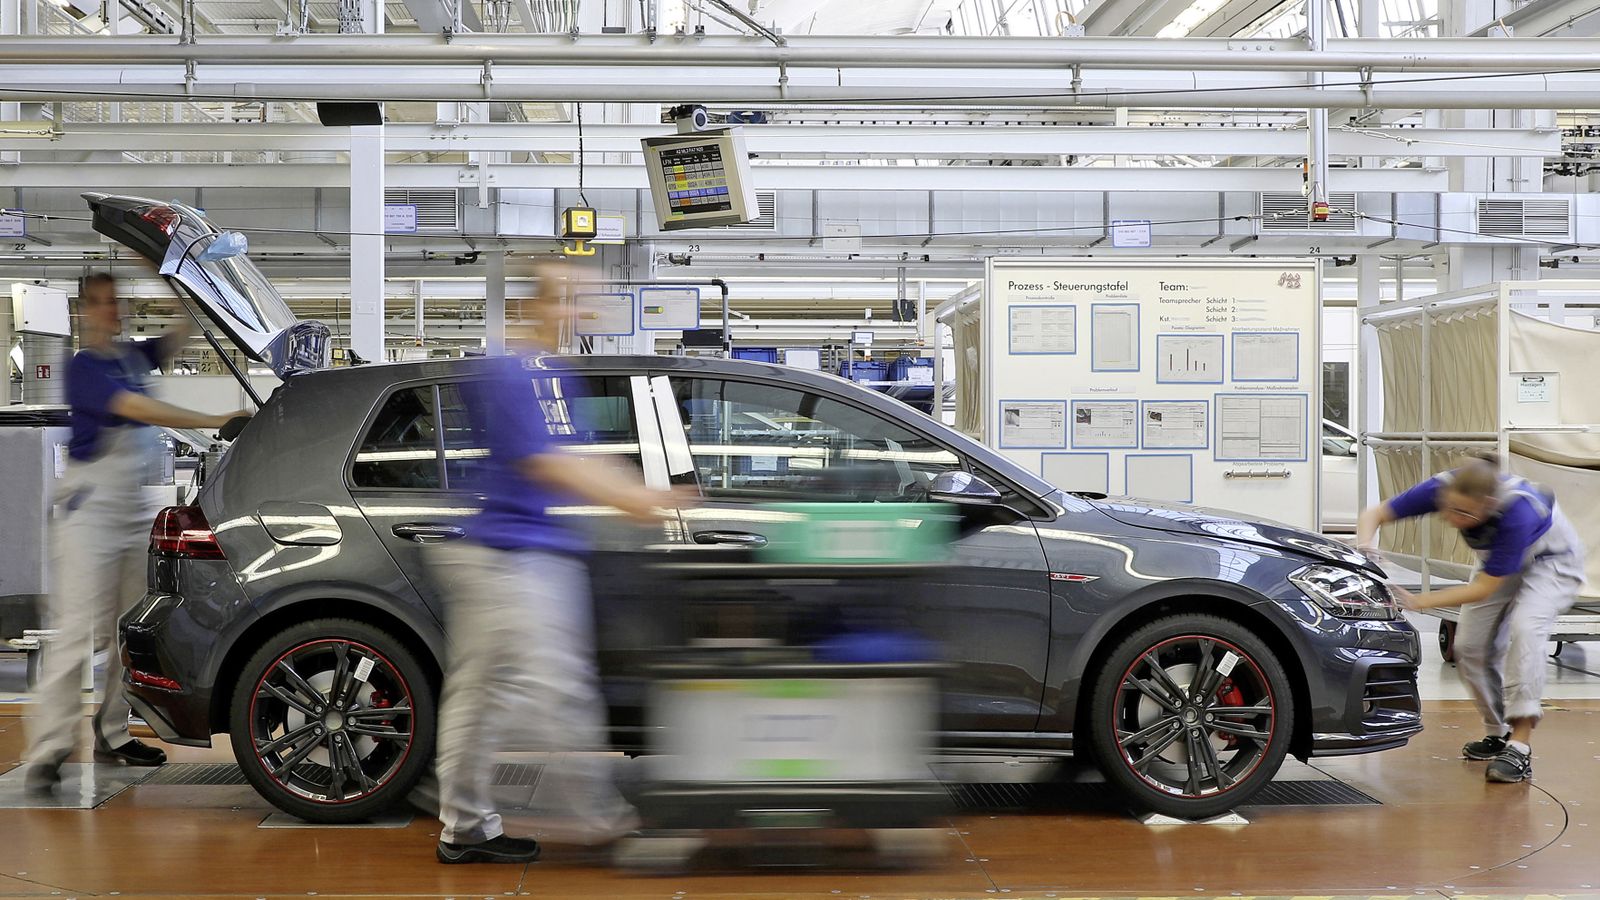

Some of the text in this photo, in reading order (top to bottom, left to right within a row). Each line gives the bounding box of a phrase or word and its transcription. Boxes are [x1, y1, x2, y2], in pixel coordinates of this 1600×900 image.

[1008, 281, 1044, 290] Prozess
[1053, 280, 1128, 293] Steuerungstafel
[1159, 281, 1189, 291] Team:
[1159, 297, 1201, 305] Teamsprecher
